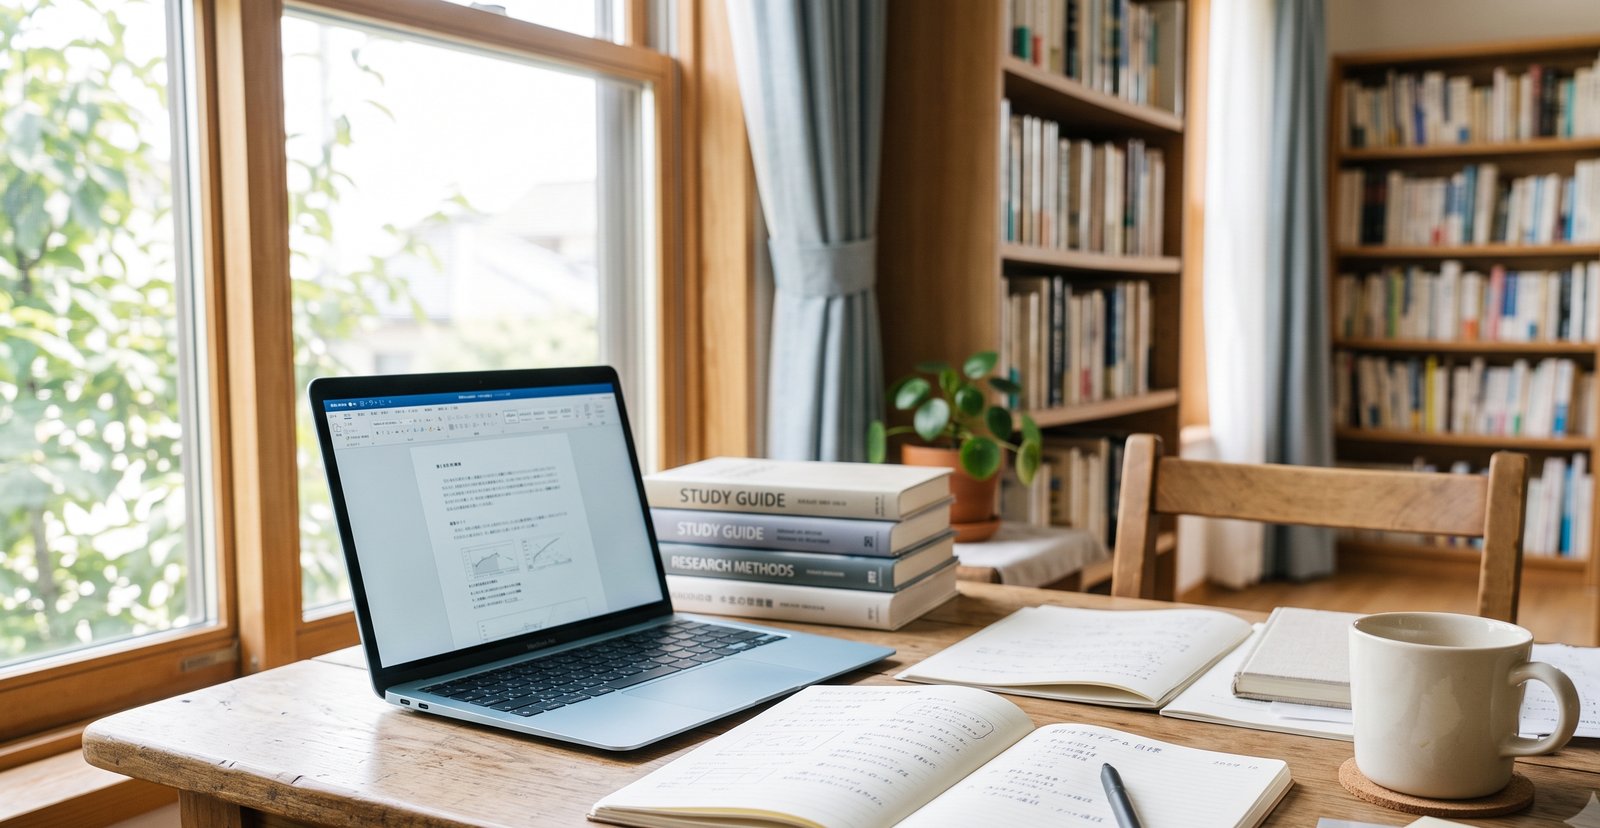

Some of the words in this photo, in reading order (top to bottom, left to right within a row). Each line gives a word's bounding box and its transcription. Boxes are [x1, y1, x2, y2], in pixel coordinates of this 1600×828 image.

[680, 488, 731, 505] STUDY
[735, 491, 786, 508] GUIDE
[677, 521, 720, 537] STUDY
[722, 524, 764, 541] GUIDE
[671, 555, 732, 573] RESEARCH
[734, 560, 795, 578] METHODS
